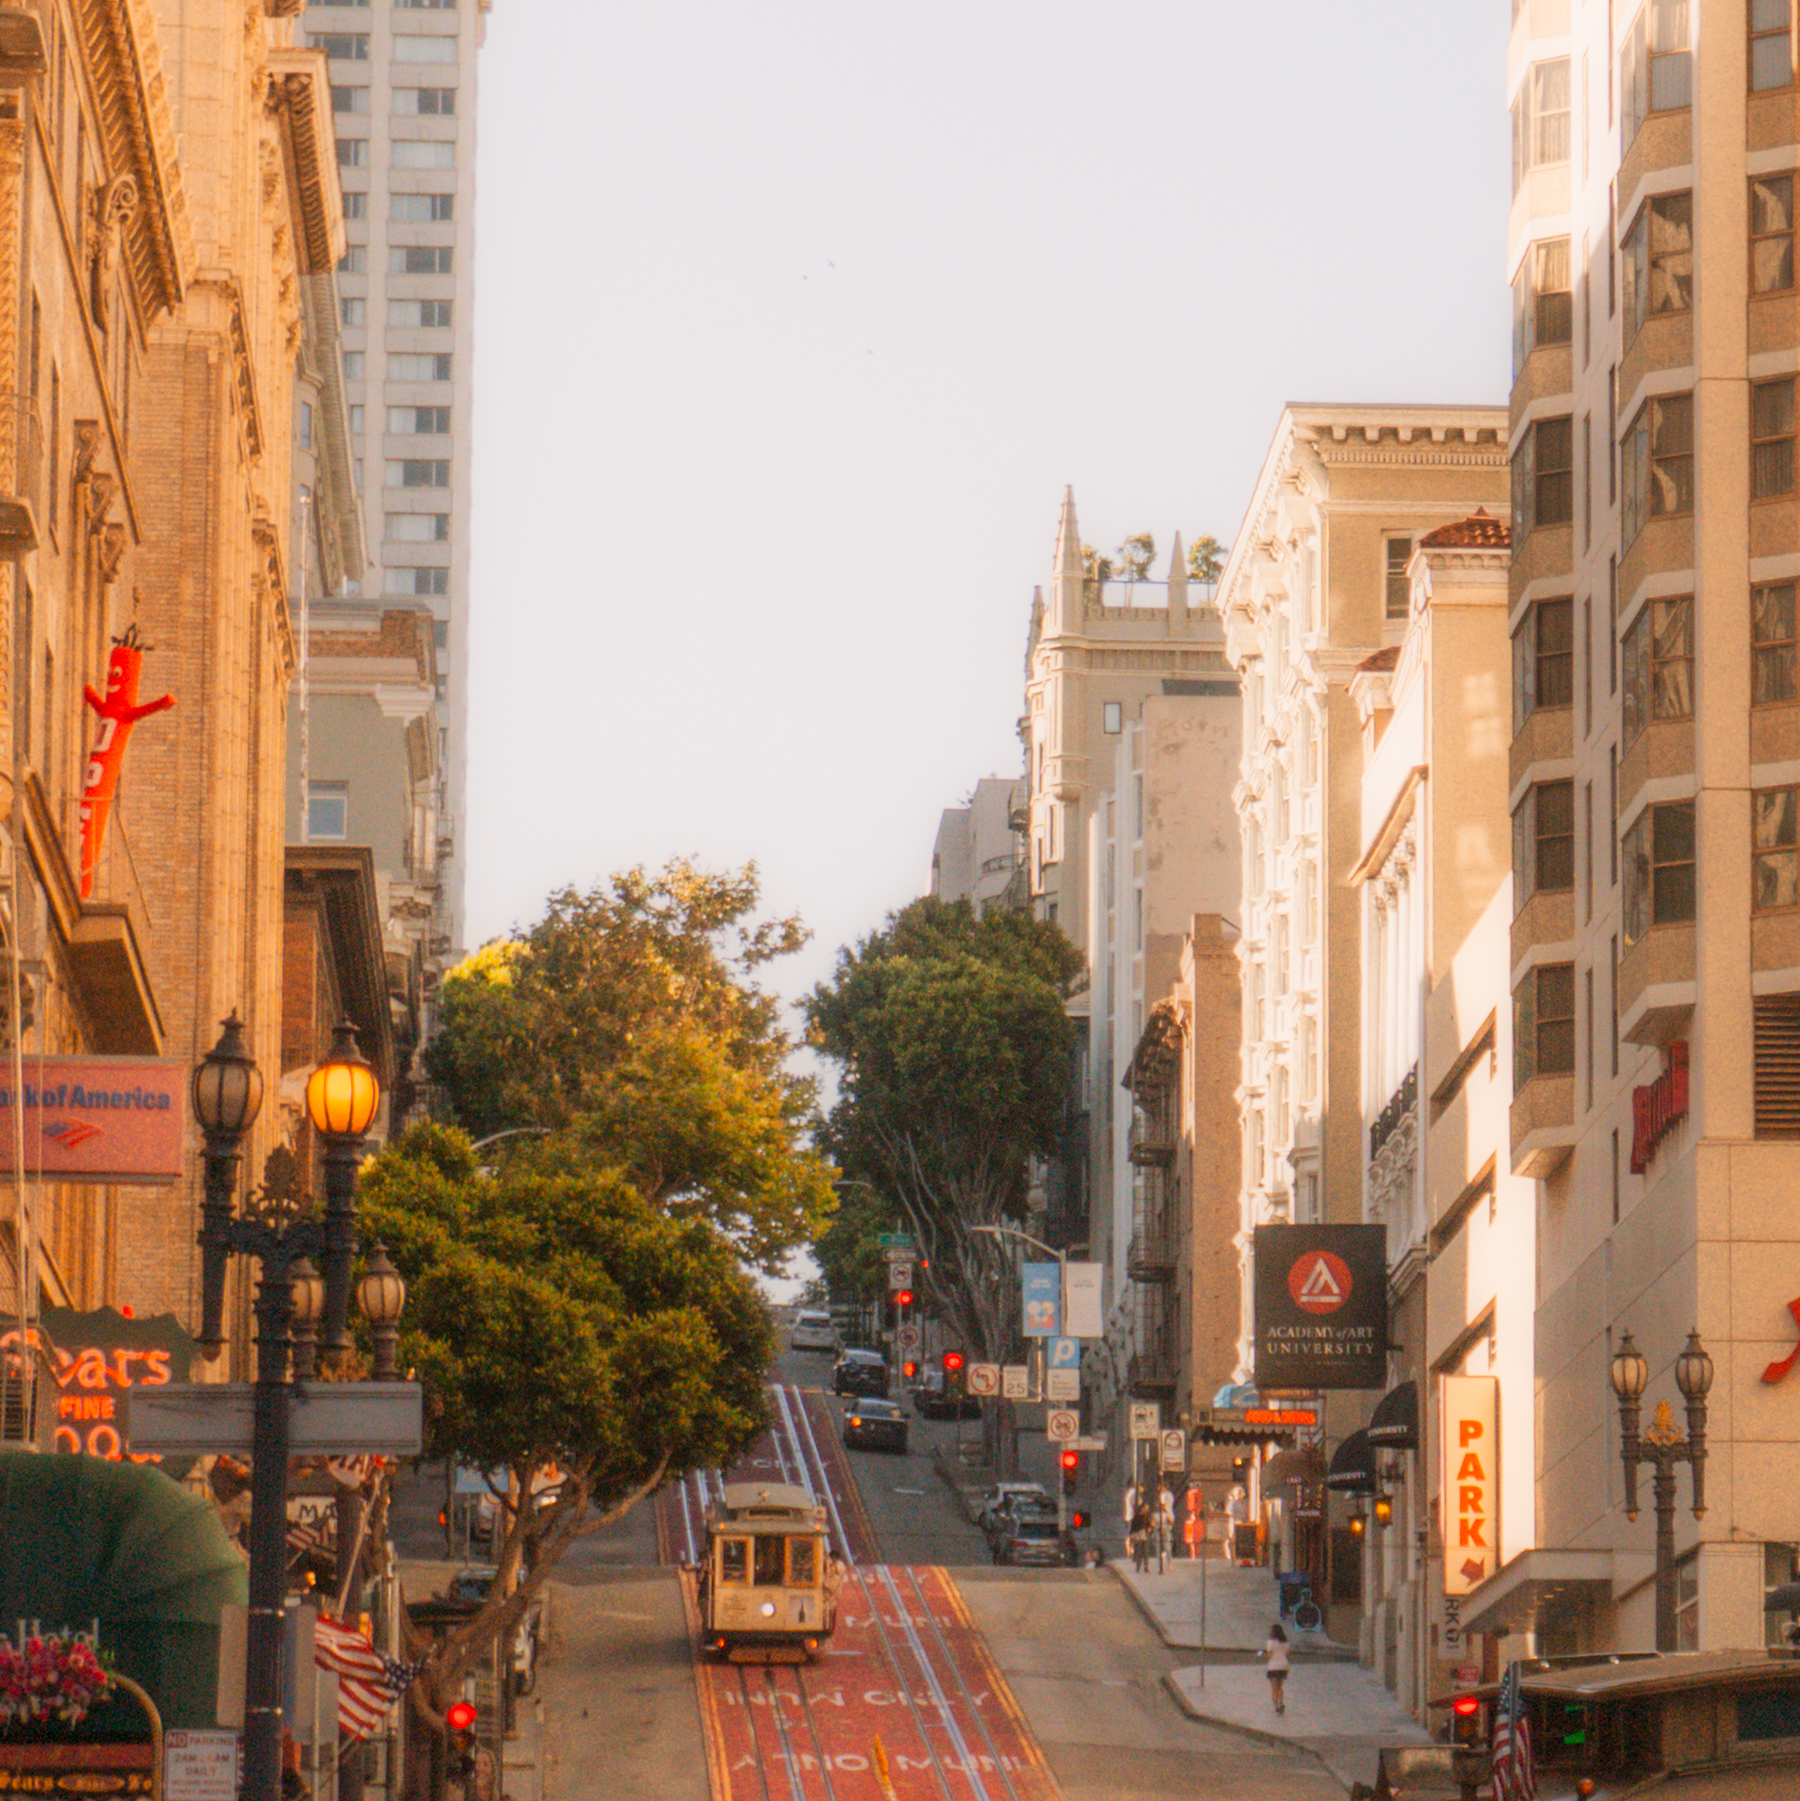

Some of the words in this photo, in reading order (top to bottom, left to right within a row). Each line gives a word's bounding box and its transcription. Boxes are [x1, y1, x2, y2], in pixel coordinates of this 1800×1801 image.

[70, 1084, 171, 1109] America
[1267, 1326, 1334, 1338] ACADEMY
[1348, 1326, 1374, 1338] ART
[1267, 1342, 1374, 1354] UNIVERSITY
[1006, 1382, 1026, 1394] 25
[59, 1396, 115, 1420] FINE
[1456, 1419, 1488, 1547] PARK
[167, 1732, 187, 1747] NO
[190, 1736, 234, 1746] PARKING
